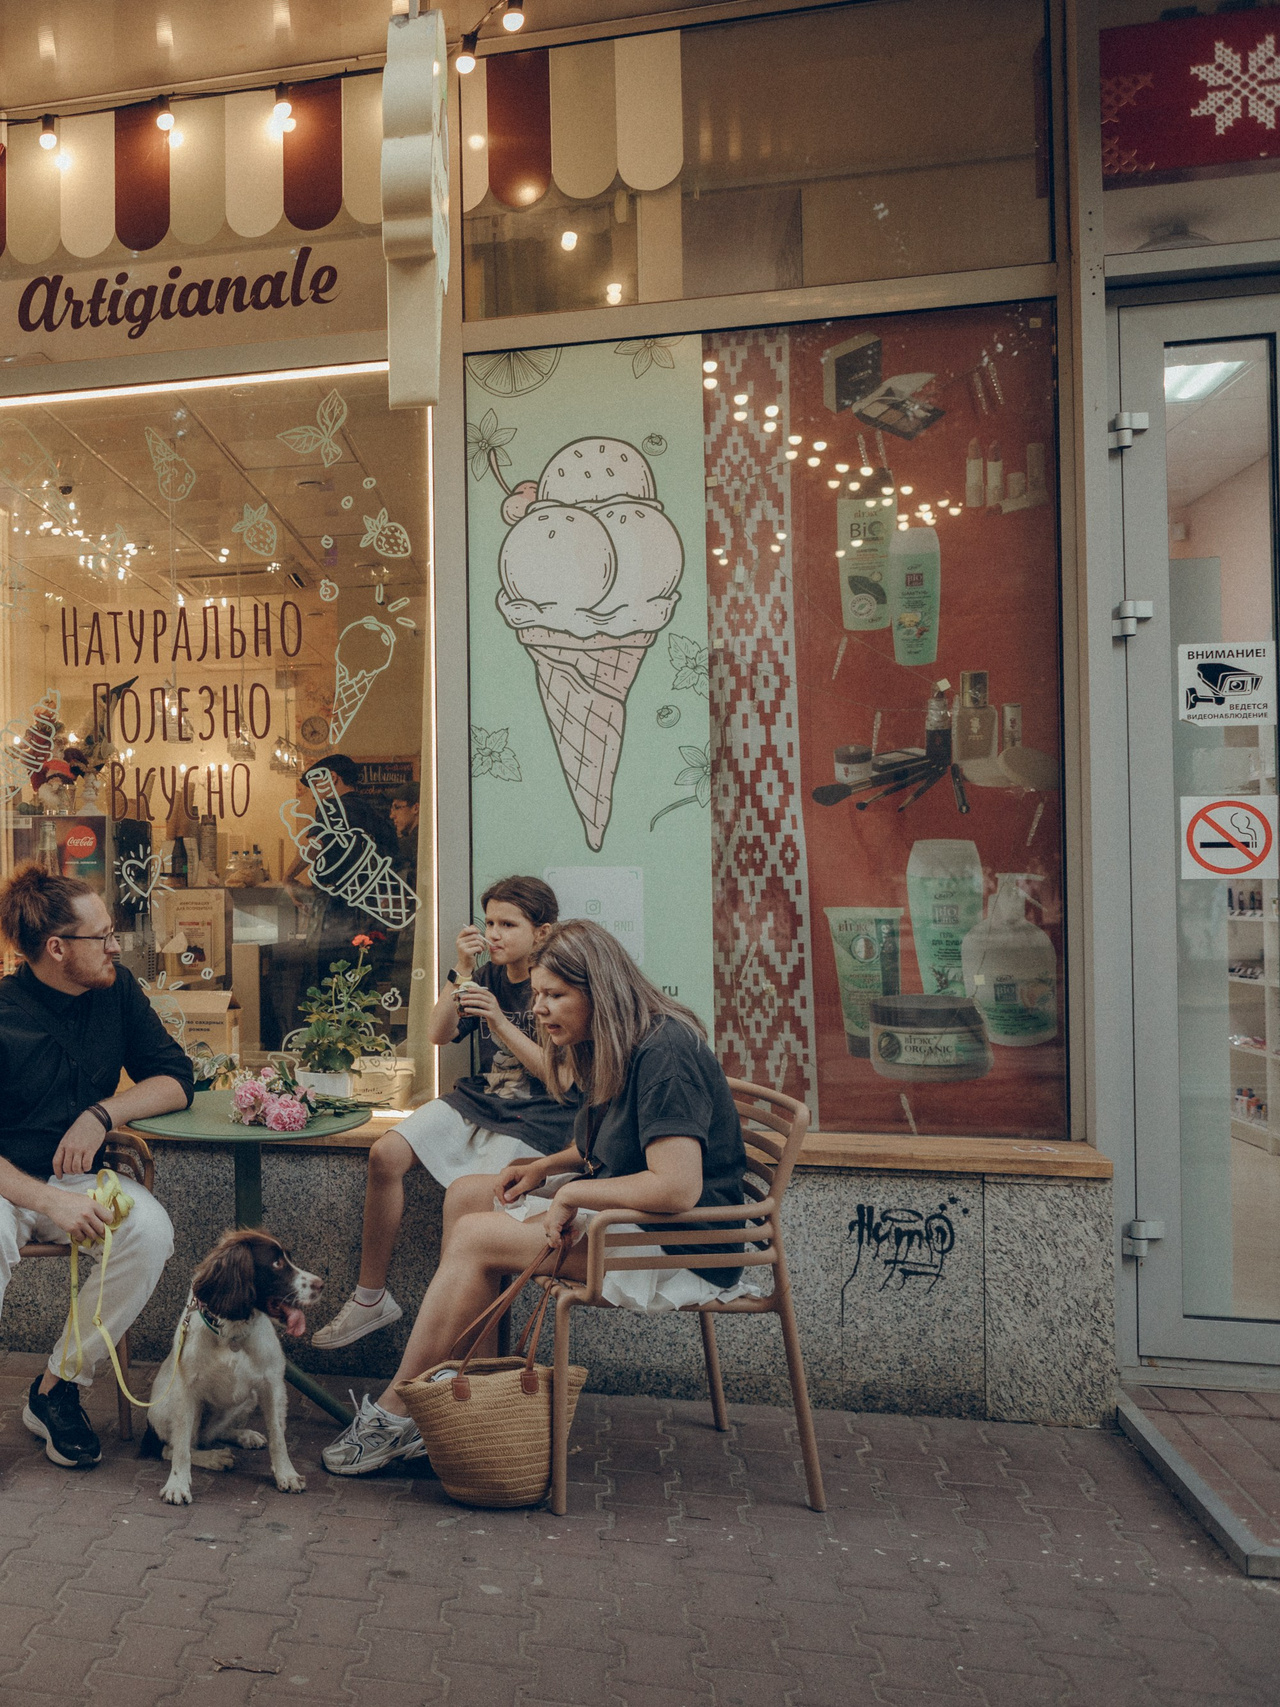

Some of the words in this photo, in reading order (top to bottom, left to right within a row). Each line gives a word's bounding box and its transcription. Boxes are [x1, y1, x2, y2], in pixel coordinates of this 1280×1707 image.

[17, 246, 339, 340] Artigianale
[61, 600, 303, 667] НАТУРАЛЬНО
[1187, 648, 1266, 660] ВНИМАНИЕ!
[92, 682, 271, 744] ПОЛЕЗНО
[1186, 711, 1268, 720] ВИДЕОНАБЛЮДЕНИЕ
[1229, 702, 1268, 711] ВЕДЕТСЯ
[110, 762, 251, 822] ВКУСНО
